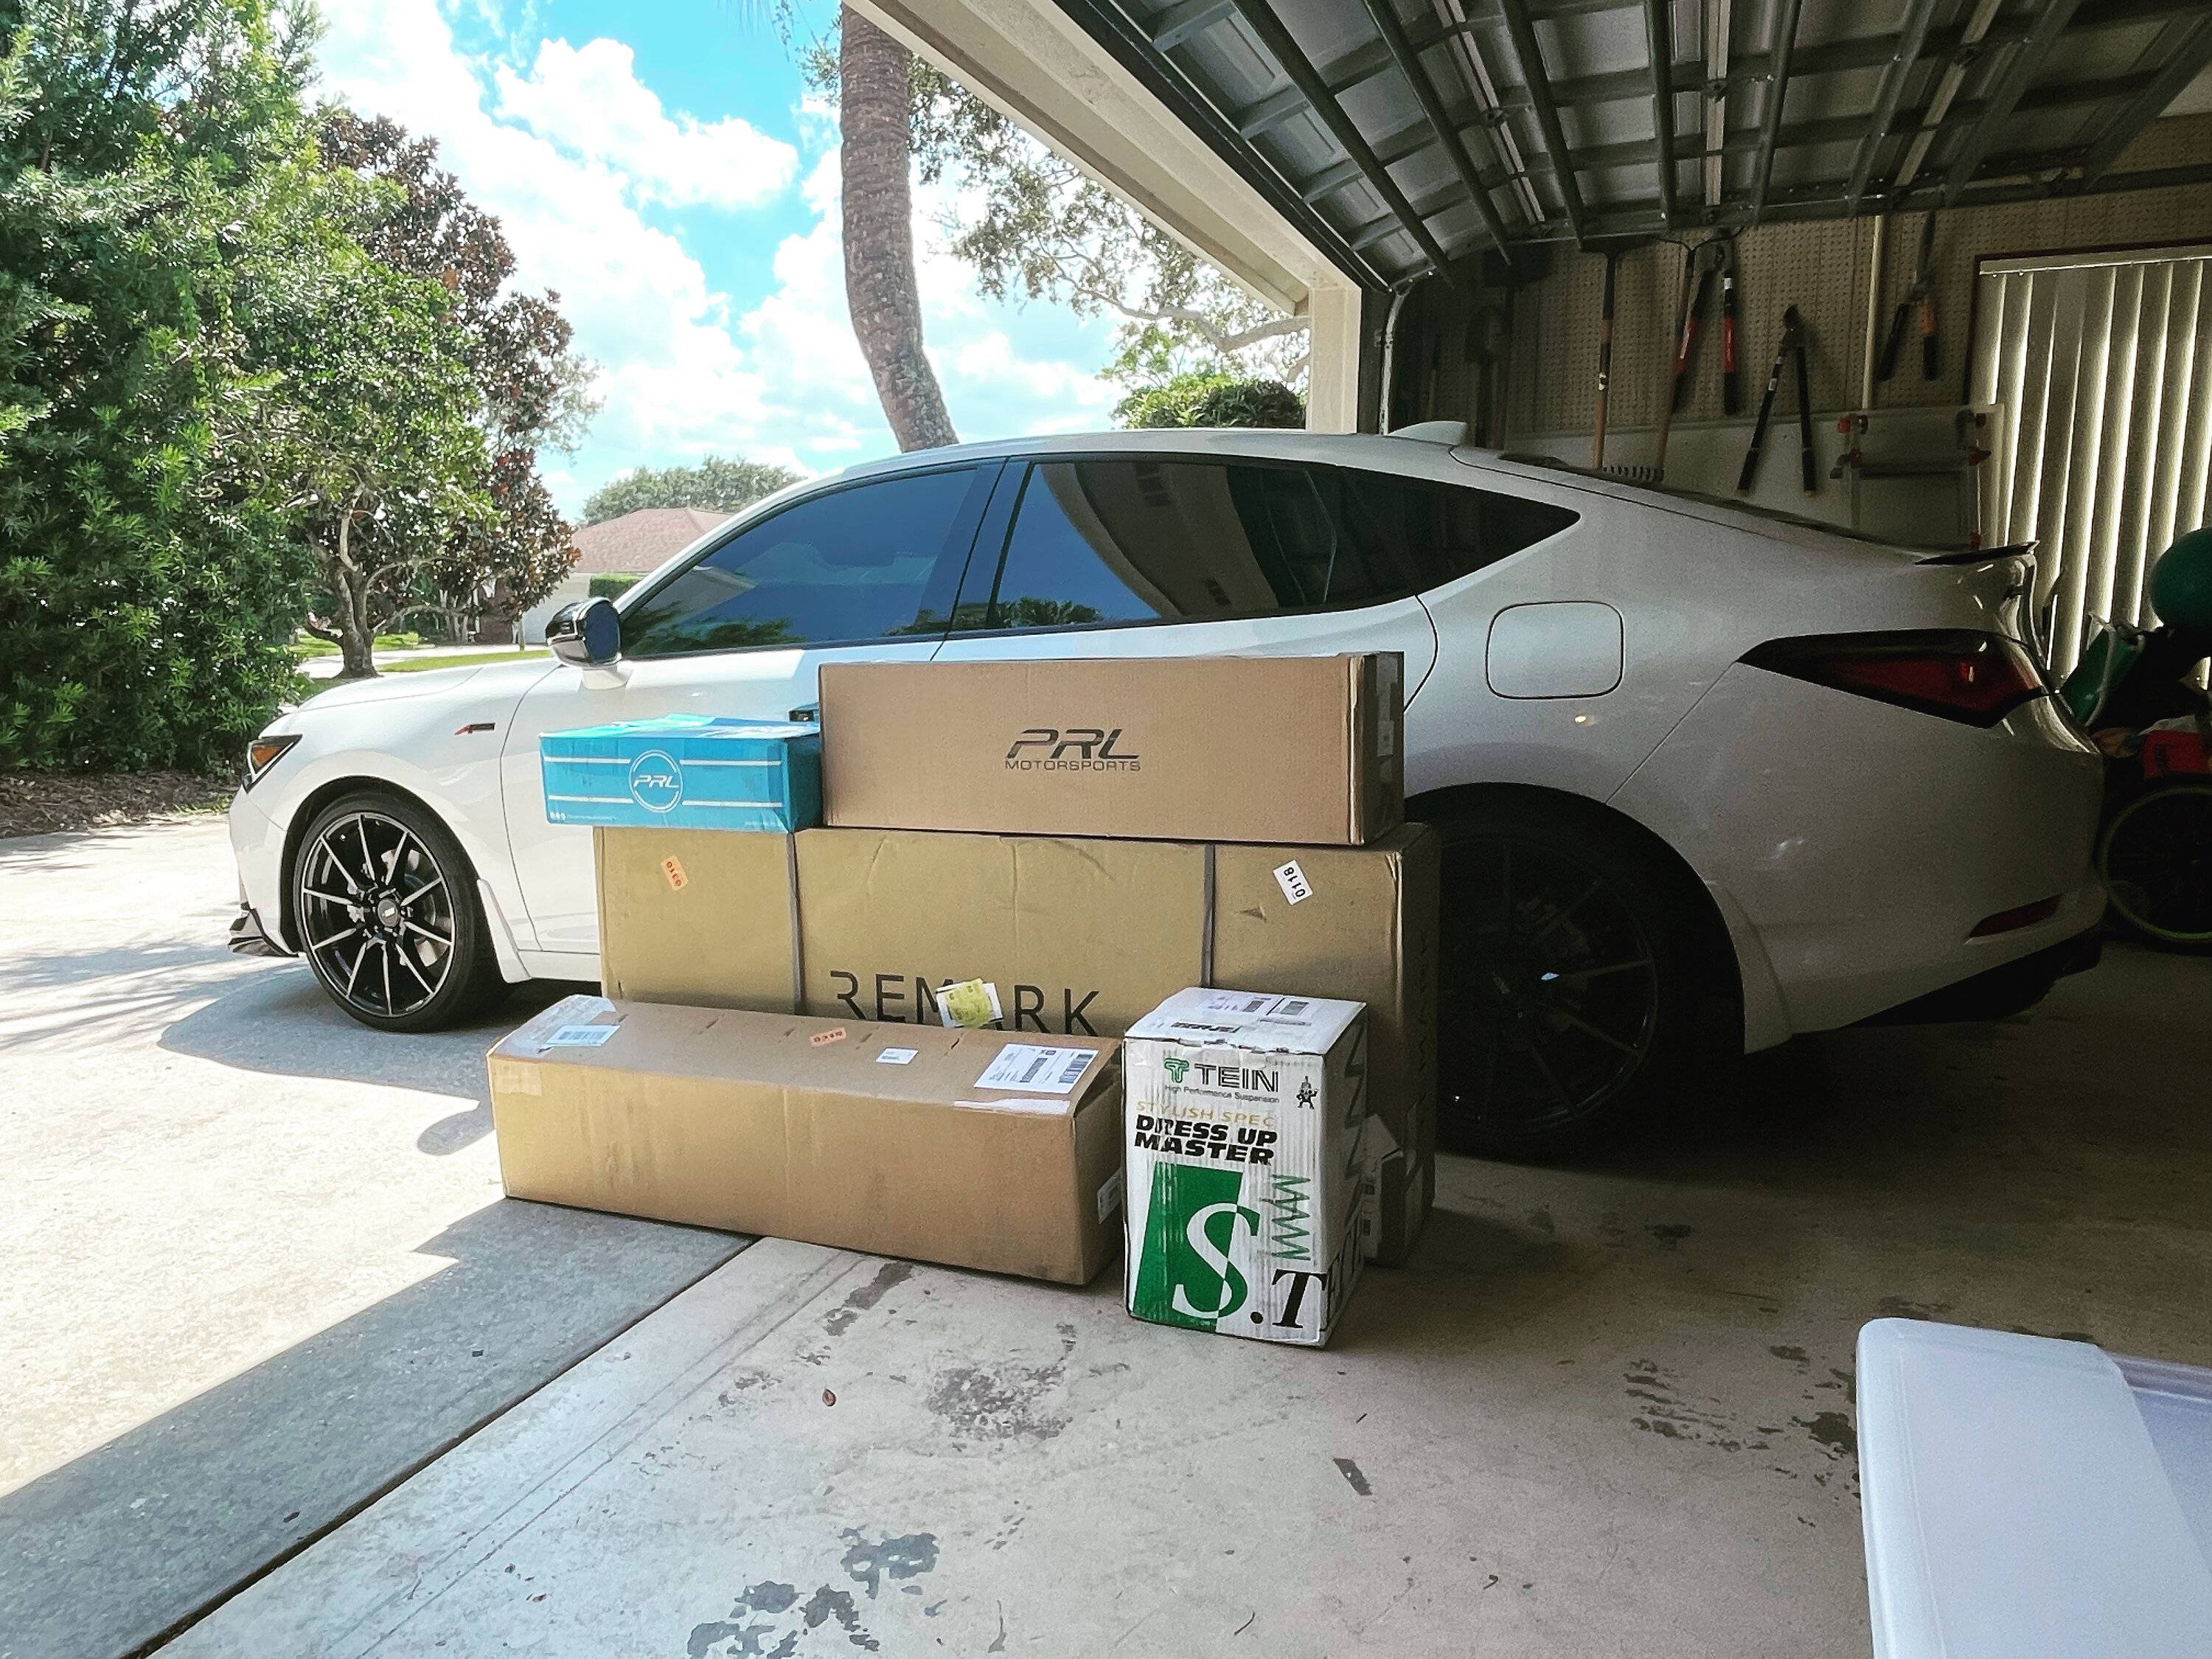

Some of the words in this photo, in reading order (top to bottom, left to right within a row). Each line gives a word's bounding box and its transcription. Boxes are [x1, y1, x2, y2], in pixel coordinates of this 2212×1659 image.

[1006, 728, 1140, 759] PRL
[633, 773, 680, 788] PRL
[1005, 759, 1141, 772] MOTORSPORTS
[1283, 866, 1306, 897] 0118
[830, 970, 1099, 1037] REMRK
[1194, 1063, 1279, 1093] TEIN
[1183, 1086, 1232, 1099] Performance
[1234, 1092, 1280, 1103] Suspension
[1135, 1114, 1229, 1142] DRESS
[1237, 1127, 1279, 1147] UP
[1221, 1111, 1276, 1127] SPEC
[1134, 1131, 1275, 1166] MASTER
